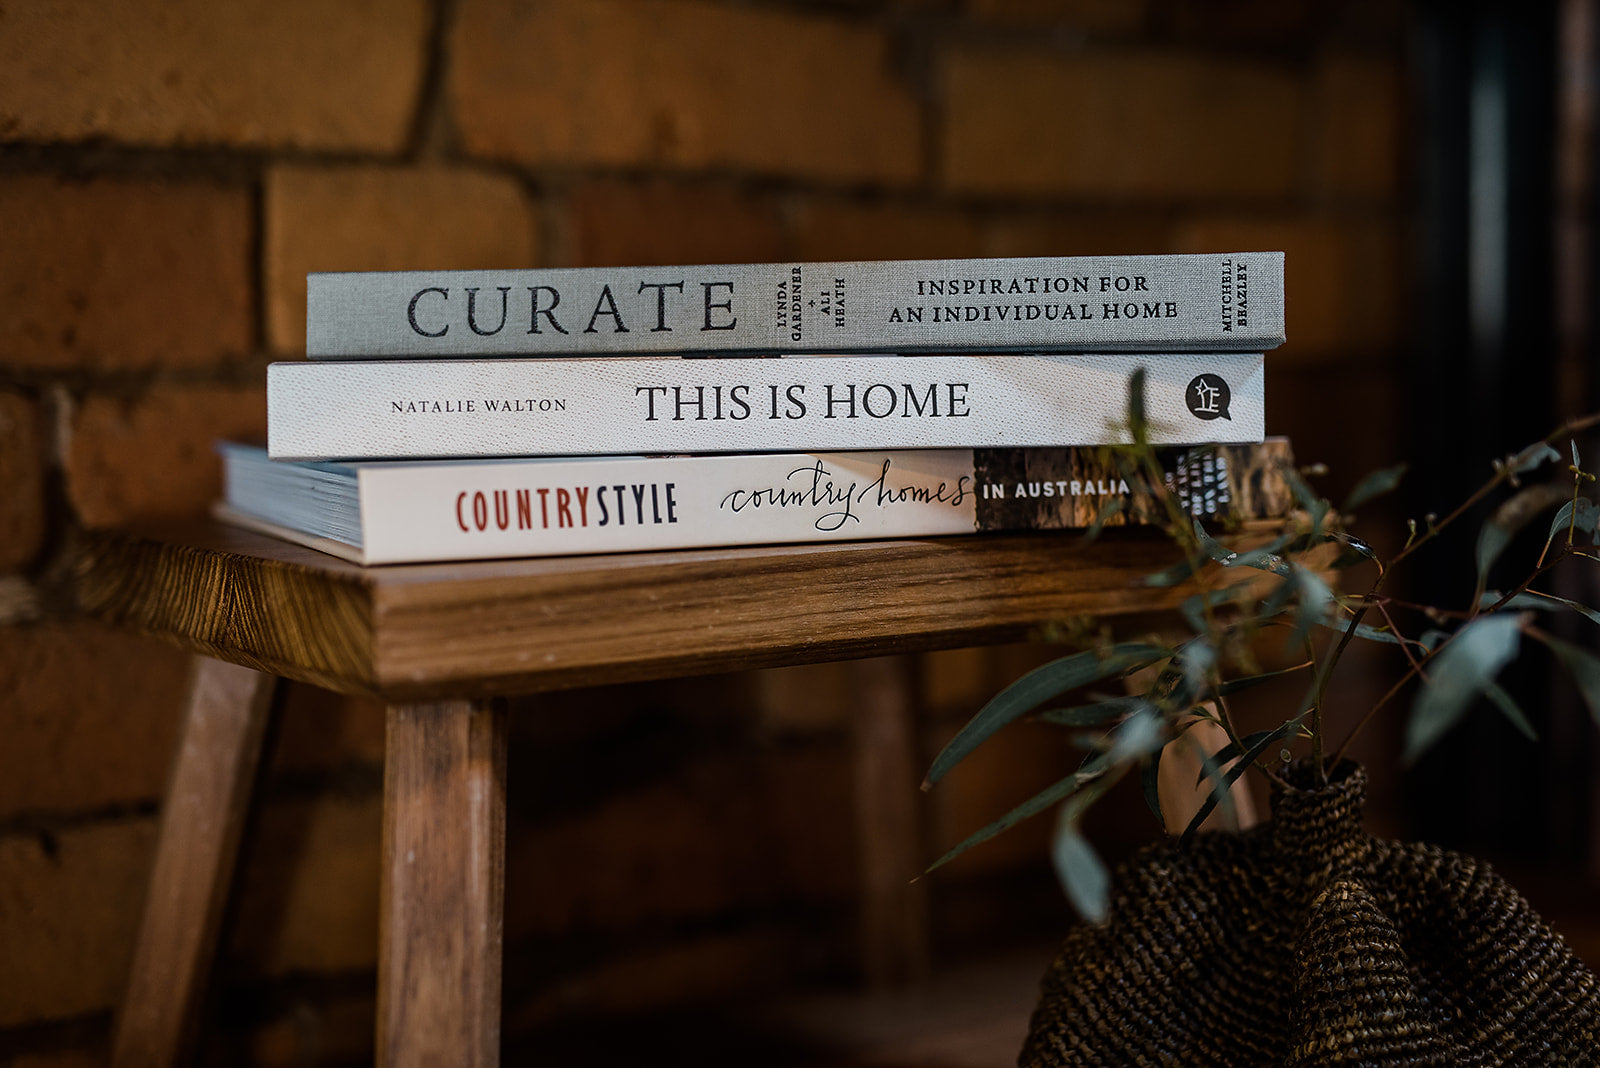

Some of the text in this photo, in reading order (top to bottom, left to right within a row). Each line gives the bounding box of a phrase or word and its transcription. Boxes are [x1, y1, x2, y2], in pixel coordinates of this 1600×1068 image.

[407, 279, 737, 337] CURATE
[777, 281, 787, 328] LYNDA
[791, 266, 802, 342] GARDENER
[821, 291, 831, 316] ALI
[835, 278, 845, 328] HEATH
[917, 276, 1149, 296] INSPIRATION FOR
[1221, 259, 1233, 332] MITCHELL
[1237, 263, 1248, 327] BEAZLEY
[888, 302, 1178, 323] AN INDIVIDUAL HOME
[391, 398, 567, 414] NATALIE WALTON
[635, 382, 971, 422] THIS IS HOME
[720, 458, 1131, 532] country homes IN AUSTRALIA
